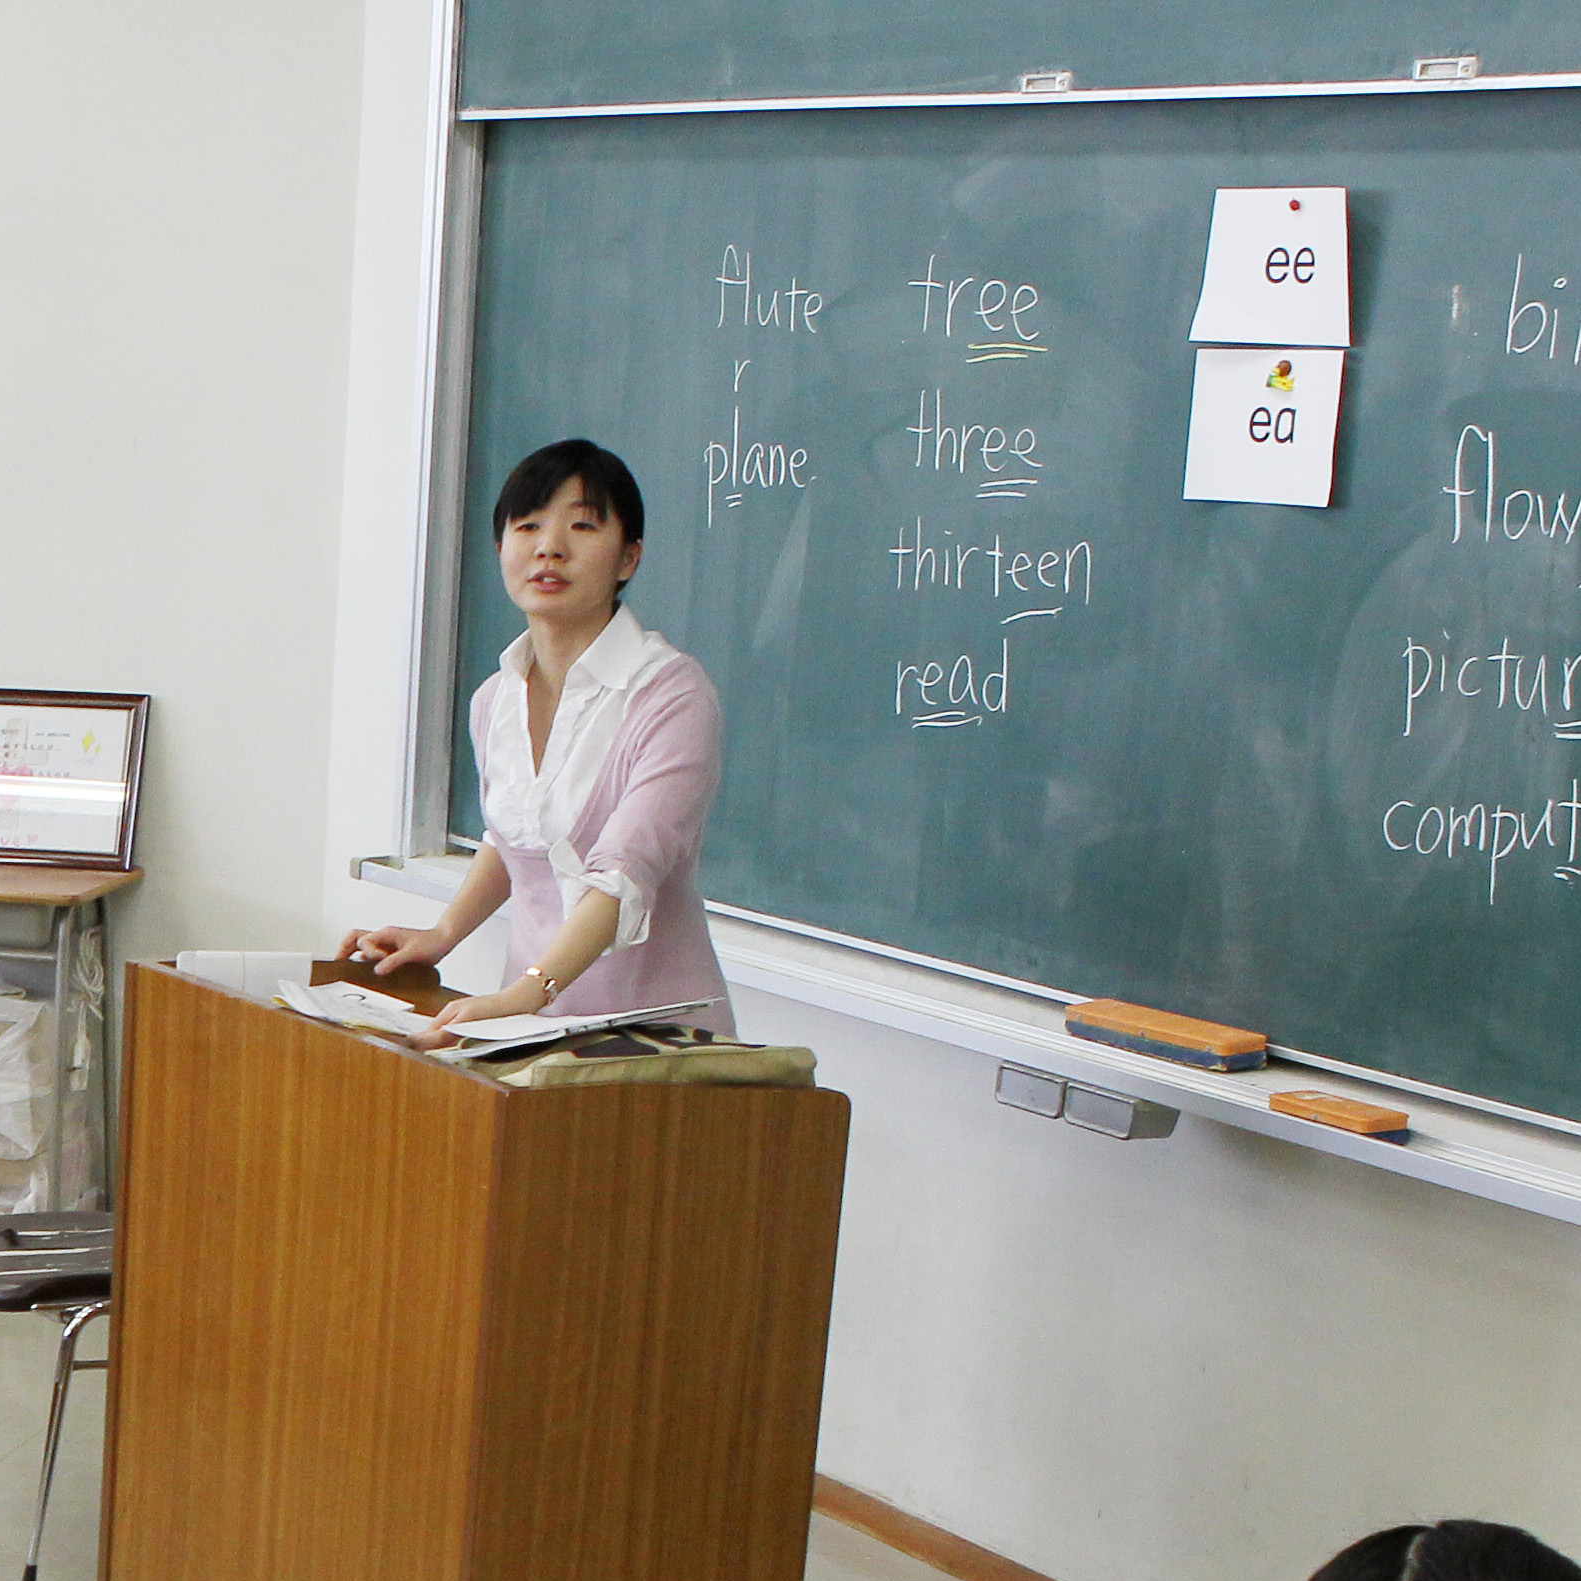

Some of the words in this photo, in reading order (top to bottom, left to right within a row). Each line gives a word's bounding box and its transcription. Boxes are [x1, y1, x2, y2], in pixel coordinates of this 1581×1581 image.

[715, 244, 823, 333] flute
[907, 253, 1040, 341] tree
[1264, 246, 1316, 284] ee
[1506, 252, 1581, 366] bi
[703, 405, 808, 529] plane
[906, 388, 1044, 473] three
[1248, 405, 1297, 444] ea
[888, 514, 1091, 606] thirteen
[895, 637, 1008, 715] read
